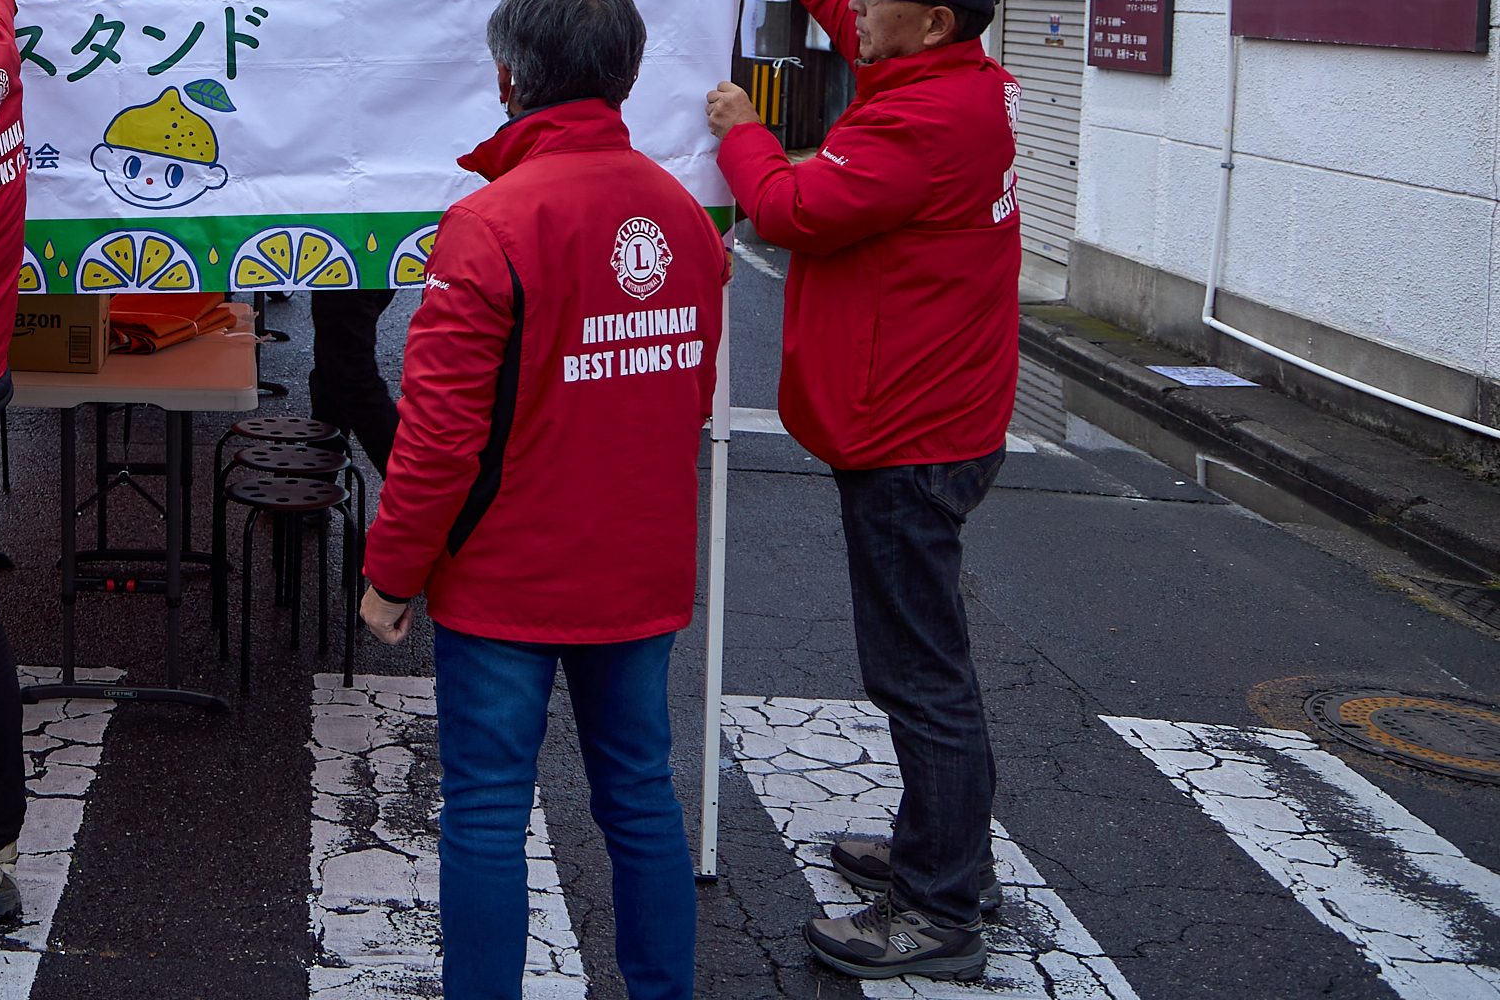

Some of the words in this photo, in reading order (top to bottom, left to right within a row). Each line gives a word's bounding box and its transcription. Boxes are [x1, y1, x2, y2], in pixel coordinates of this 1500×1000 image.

[15, 6, 269, 82] スタンド
[992, 190, 1014, 224] BEST
[620, 221, 657, 239] LIONS
[633, 244, 649, 271] L
[625, 277, 660, 293] INTERNATIONAL
[582, 306, 697, 344] HITACHINAKA
[564, 351, 614, 382] BEST
[620, 344, 672, 376] LIONS
[677, 340, 704, 369] CLUB
